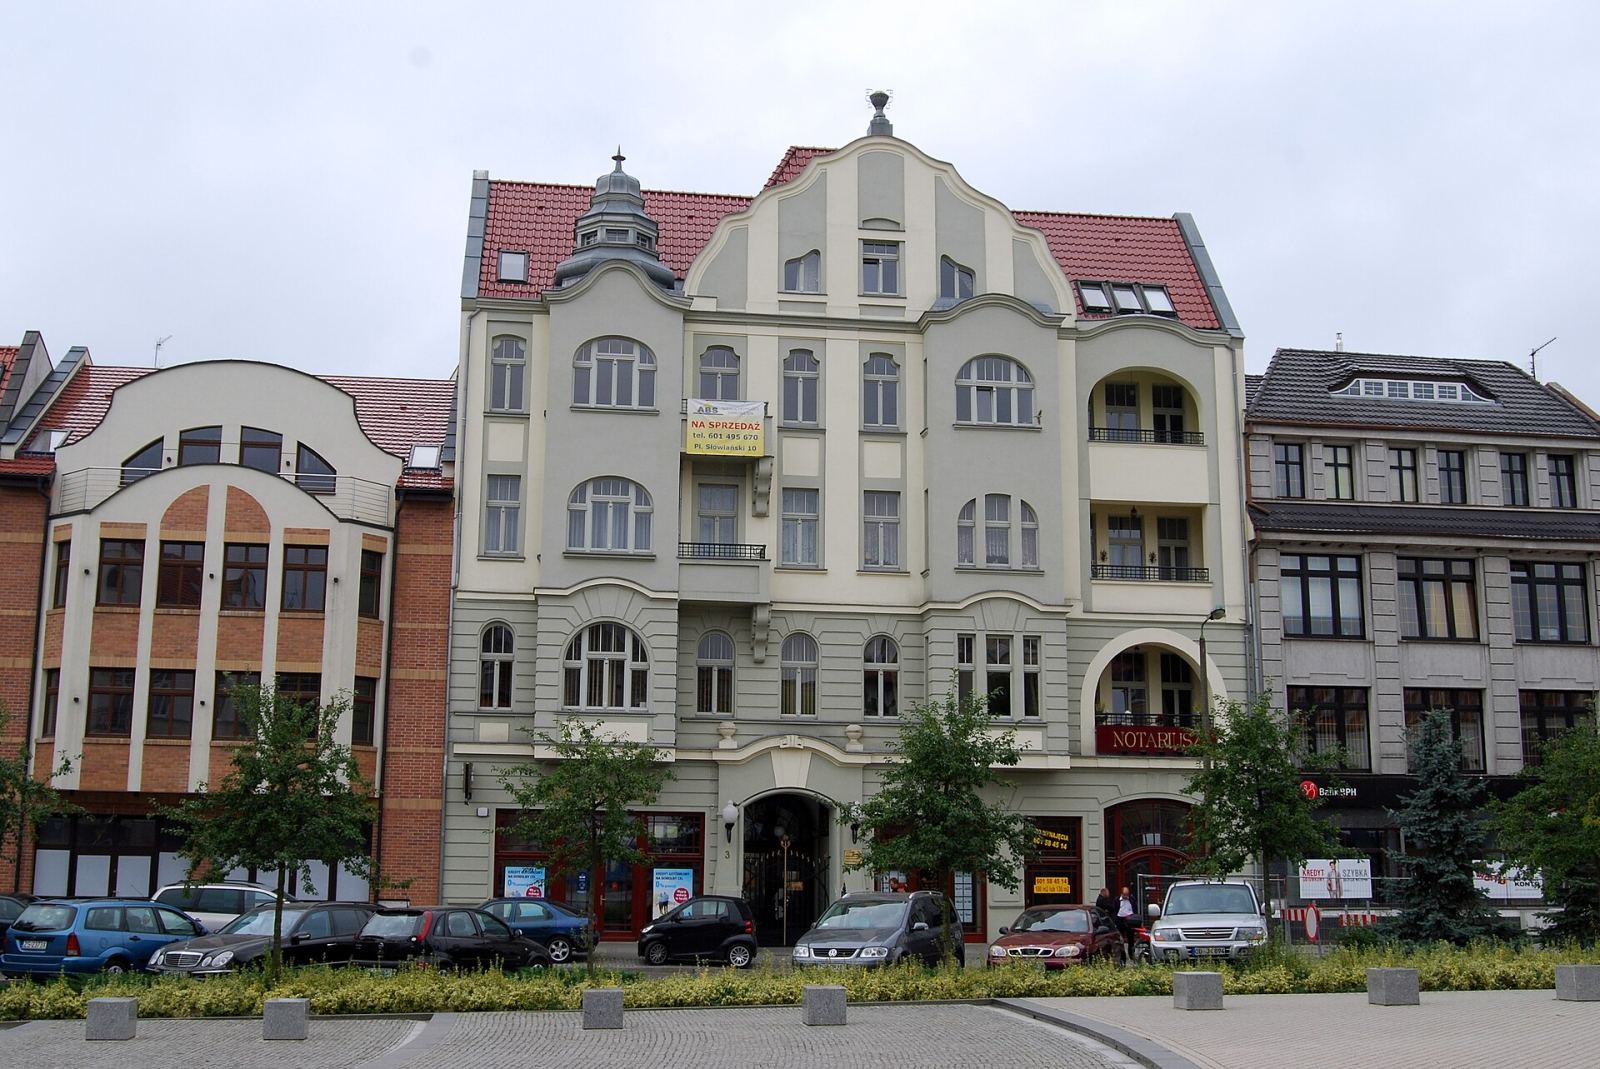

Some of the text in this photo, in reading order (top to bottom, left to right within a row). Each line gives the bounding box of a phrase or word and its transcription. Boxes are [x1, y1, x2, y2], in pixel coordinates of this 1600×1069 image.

[691, 421, 761, 431] NA SPRZEDAŻ
[725, 850, 730, 860] 3
[1302, 868, 1368, 878] KREDYT SZYBKA
